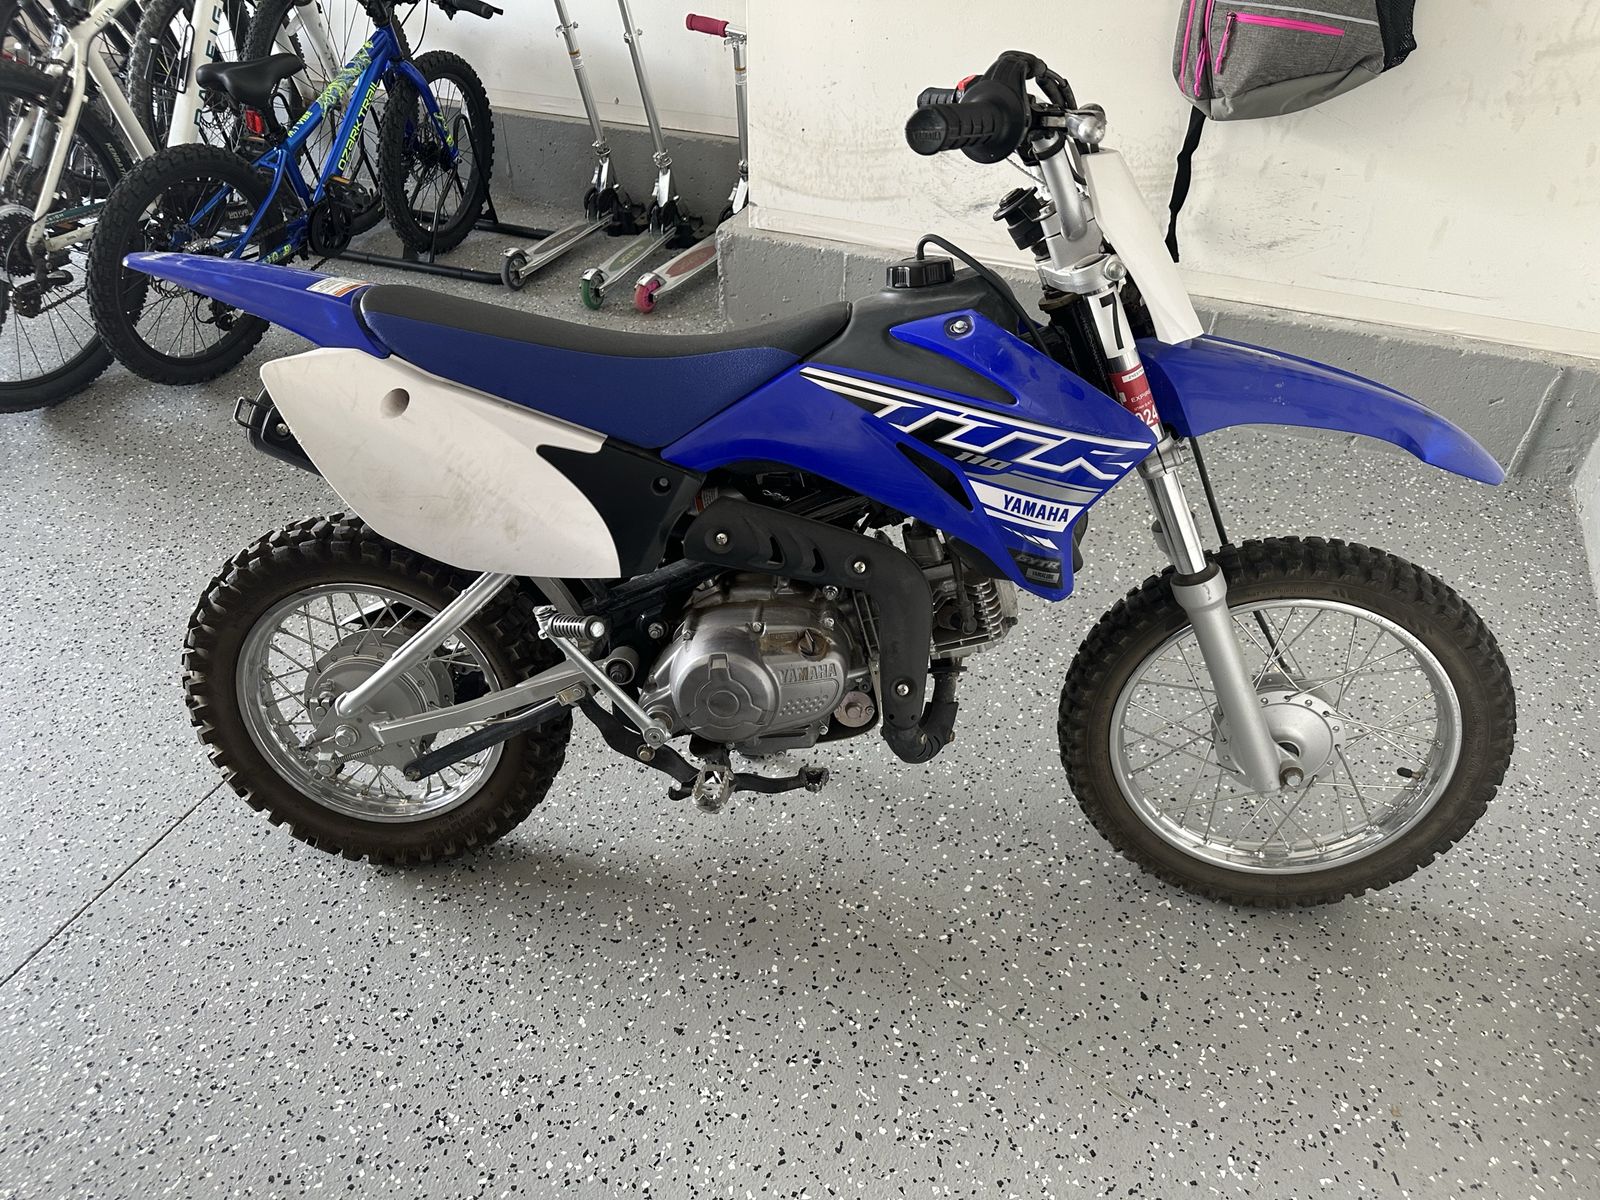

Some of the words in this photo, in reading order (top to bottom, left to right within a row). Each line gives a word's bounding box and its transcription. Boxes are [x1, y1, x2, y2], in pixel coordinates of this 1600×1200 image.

[1099, 291, 1124, 351] 7
[955, 452, 1012, 471] 110
[1003, 493, 1070, 524] YAMAHA
[779, 662, 837, 684] YAMAHA
